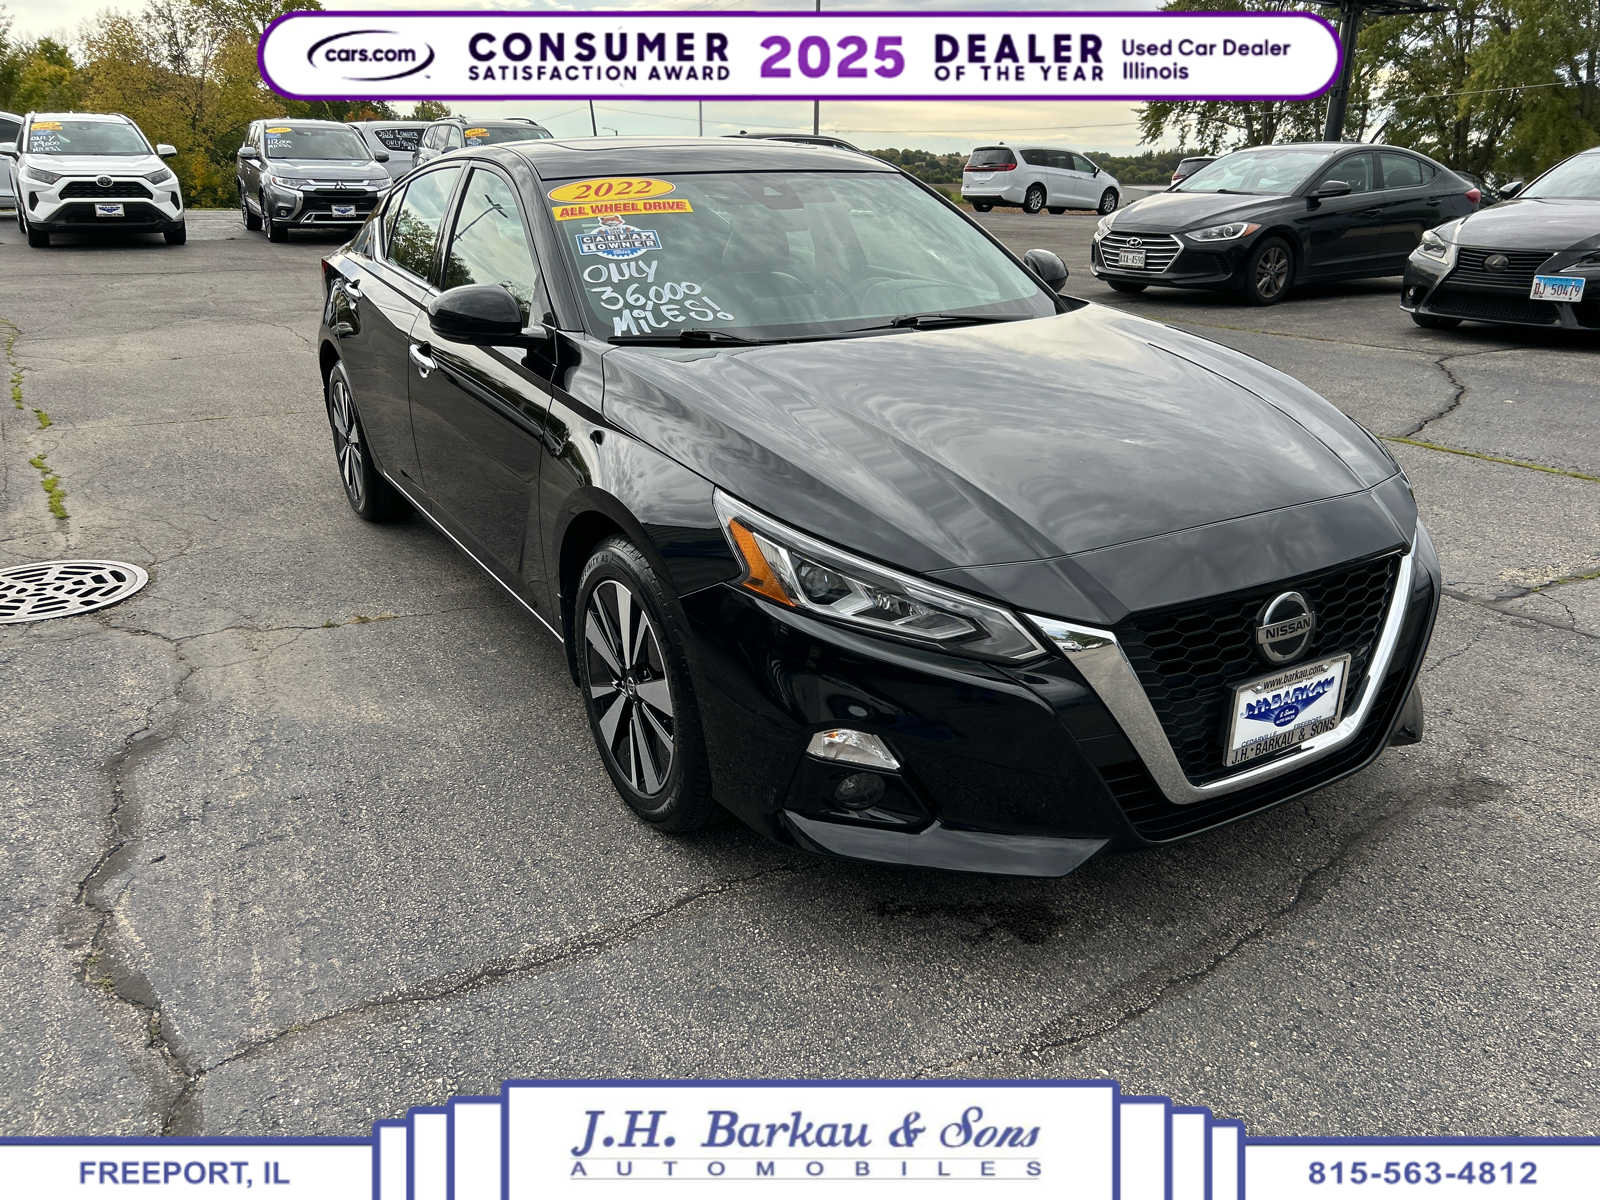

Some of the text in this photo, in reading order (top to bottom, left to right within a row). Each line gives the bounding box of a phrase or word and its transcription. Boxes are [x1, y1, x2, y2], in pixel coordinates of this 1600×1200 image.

[573, 180, 653, 200] 2022
[560, 200, 687, 218] ALL WHEEL DRIVE
[583, 231, 654, 243] CARFAX
[583, 260, 658, 284] ONLY
[591, 281, 702, 311] 36,000
[1551, 283, 1580, 298] 50479
[1265, 617, 1311, 640] NISSAN
[1263, 664, 1324, 690] www.barkau.com
[1231, 717, 1336, 764] J.H. BARKAU & SONS
